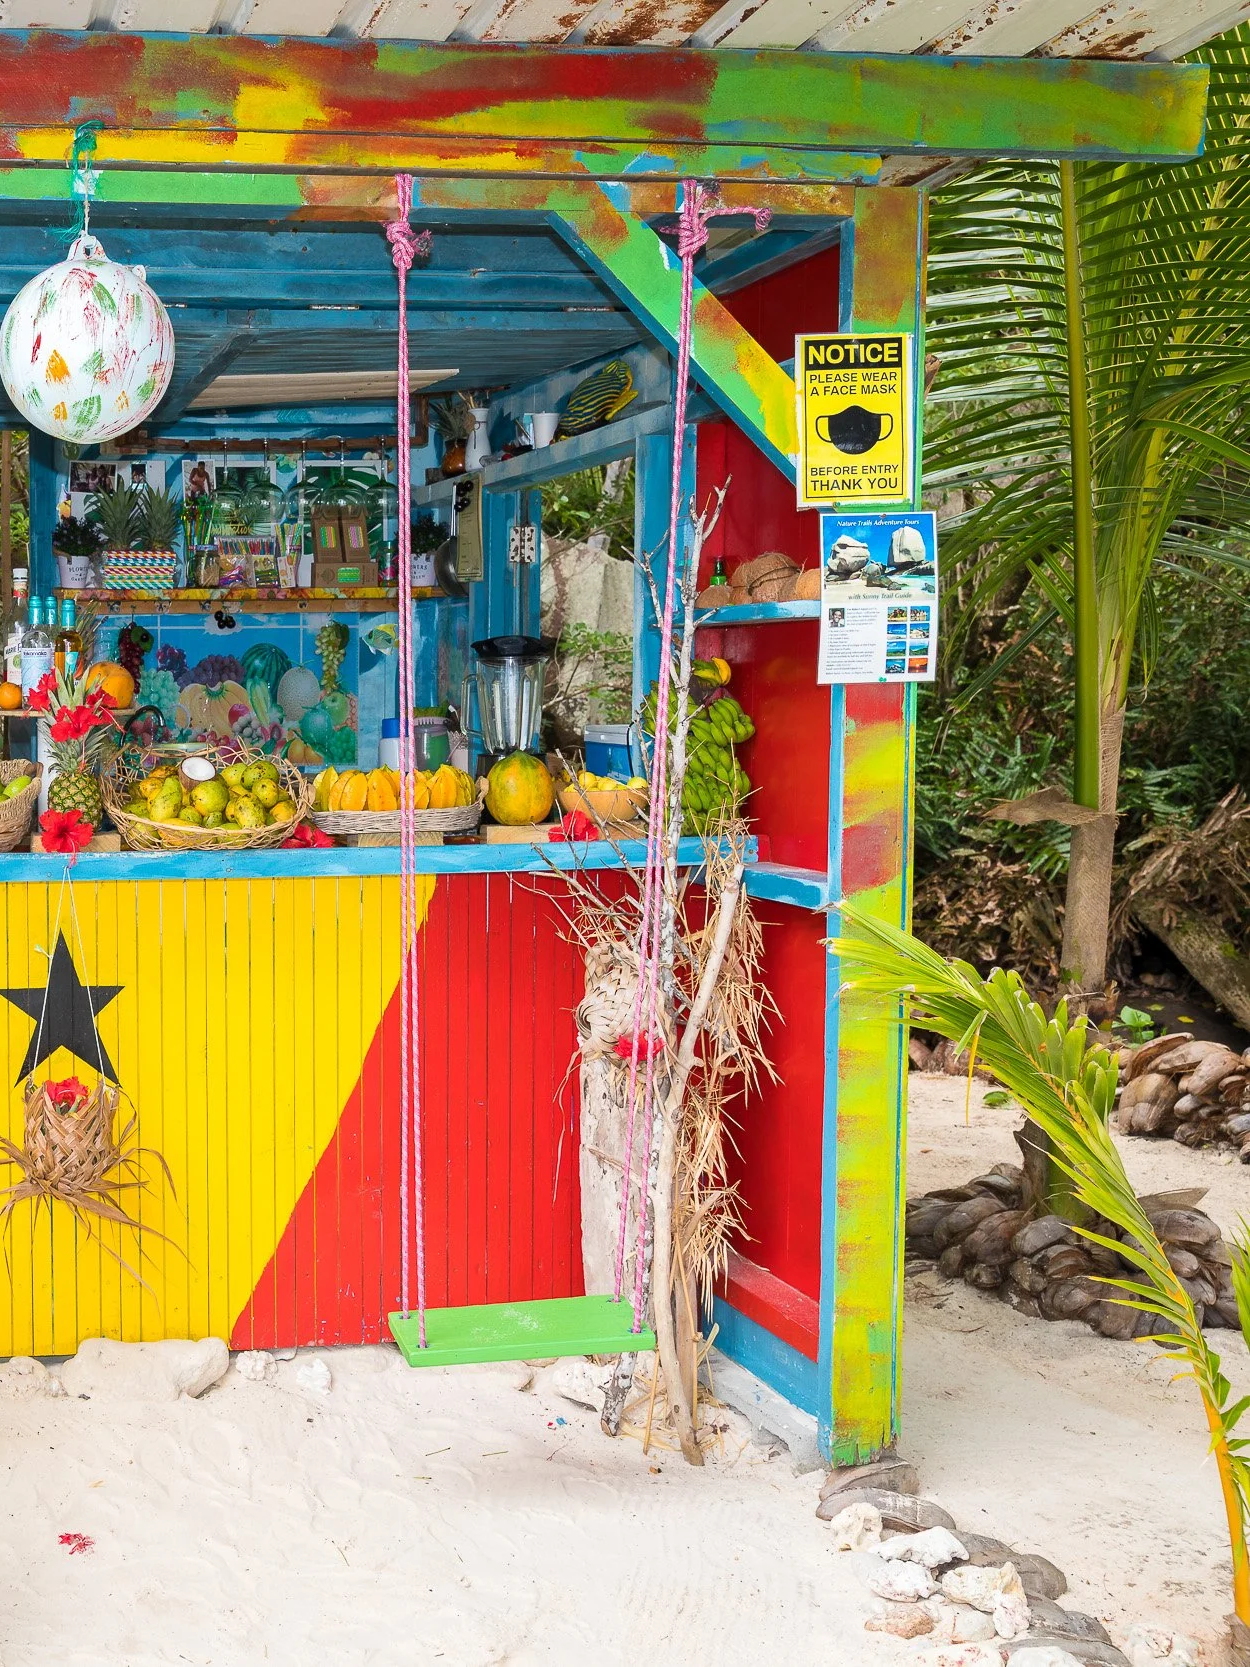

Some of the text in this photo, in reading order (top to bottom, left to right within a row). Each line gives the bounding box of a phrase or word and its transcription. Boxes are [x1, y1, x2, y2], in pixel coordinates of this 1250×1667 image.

[808, 342, 899, 365] NOTICE
[809, 371, 897, 384] PLEASE WEAR
[810, 384, 897, 396] A FACE MASK
[810, 464, 899, 476] BEFORE ENTRY
[811, 477, 898, 491] THANK YOU
[895, 592, 913, 600] Guide
